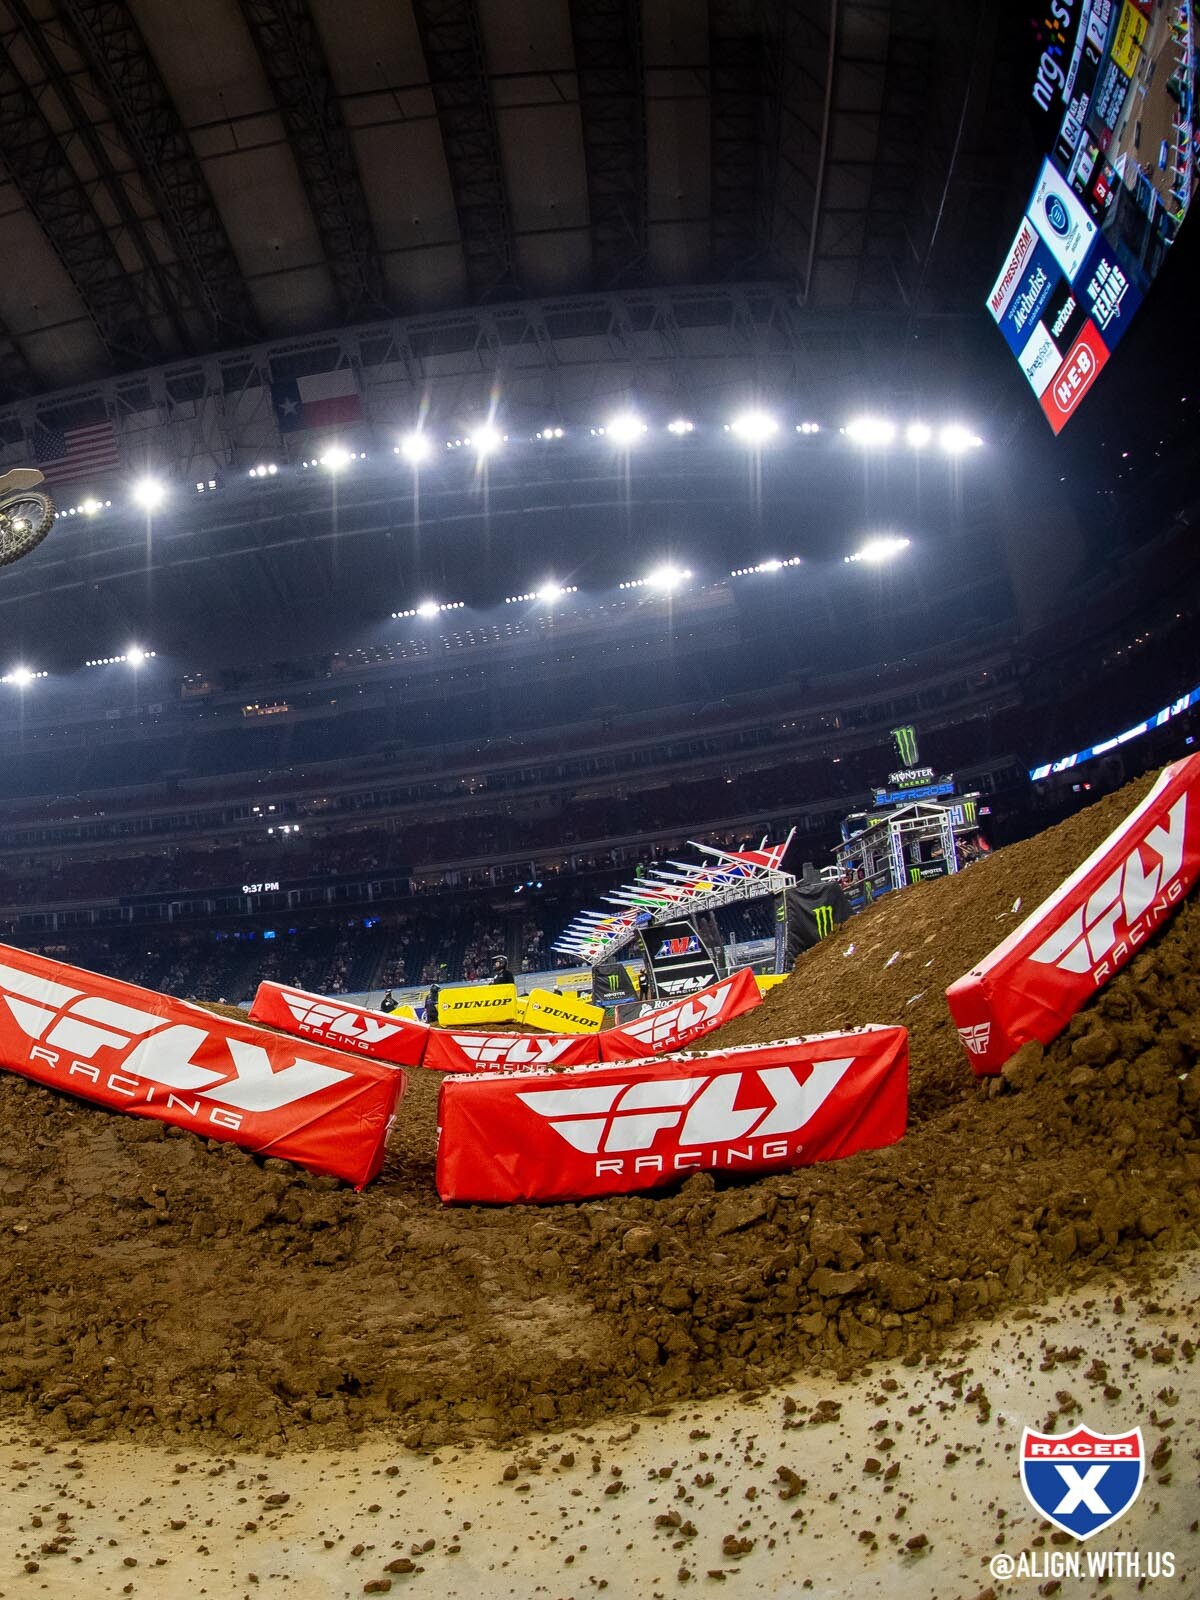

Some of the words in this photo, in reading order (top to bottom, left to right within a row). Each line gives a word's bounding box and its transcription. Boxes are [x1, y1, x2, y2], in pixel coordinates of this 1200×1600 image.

[1032, 51, 1065, 112] nrg
[1064, 118, 1078, 142] 94
[1087, 277, 1102, 300] WE
[1097, 258, 1112, 281] ARE
[1091, 264, 1128, 325] TEXANS
[1011, 267, 1047, 333] Methodist
[1051, 296, 1076, 338] verizon
[891, 768, 934, 783] MONSTER
[899, 778, 930, 788] ENERGY
[875, 783, 954, 806] SUPERCROSS
[242, 883, 263, 895] 9:37
[264, 881, 279, 893] PM
[1028, 791, 1188, 974] FLY
[655, 935, 701, 959] AMA
[1093, 877, 1183, 986] RACING
[657, 974, 714, 993] FLY
[280, 992, 404, 1043] FLY
[453, 998, 512, 1009] DUNLOP
[542, 1006, 599, 1028] DUNLOP
[620, 983, 733, 1044] FLY
[298, 1023, 370, 1051] RACING
[451, 1035, 576, 1063] FLY
[652, 1017, 717, 1050] RACING
[475, 1062, 548, 1072] RACING
[29, 1045, 244, 1131] RACING
[515, 1057, 856, 1153] FLY
[595, 1140, 788, 1177] RACING
